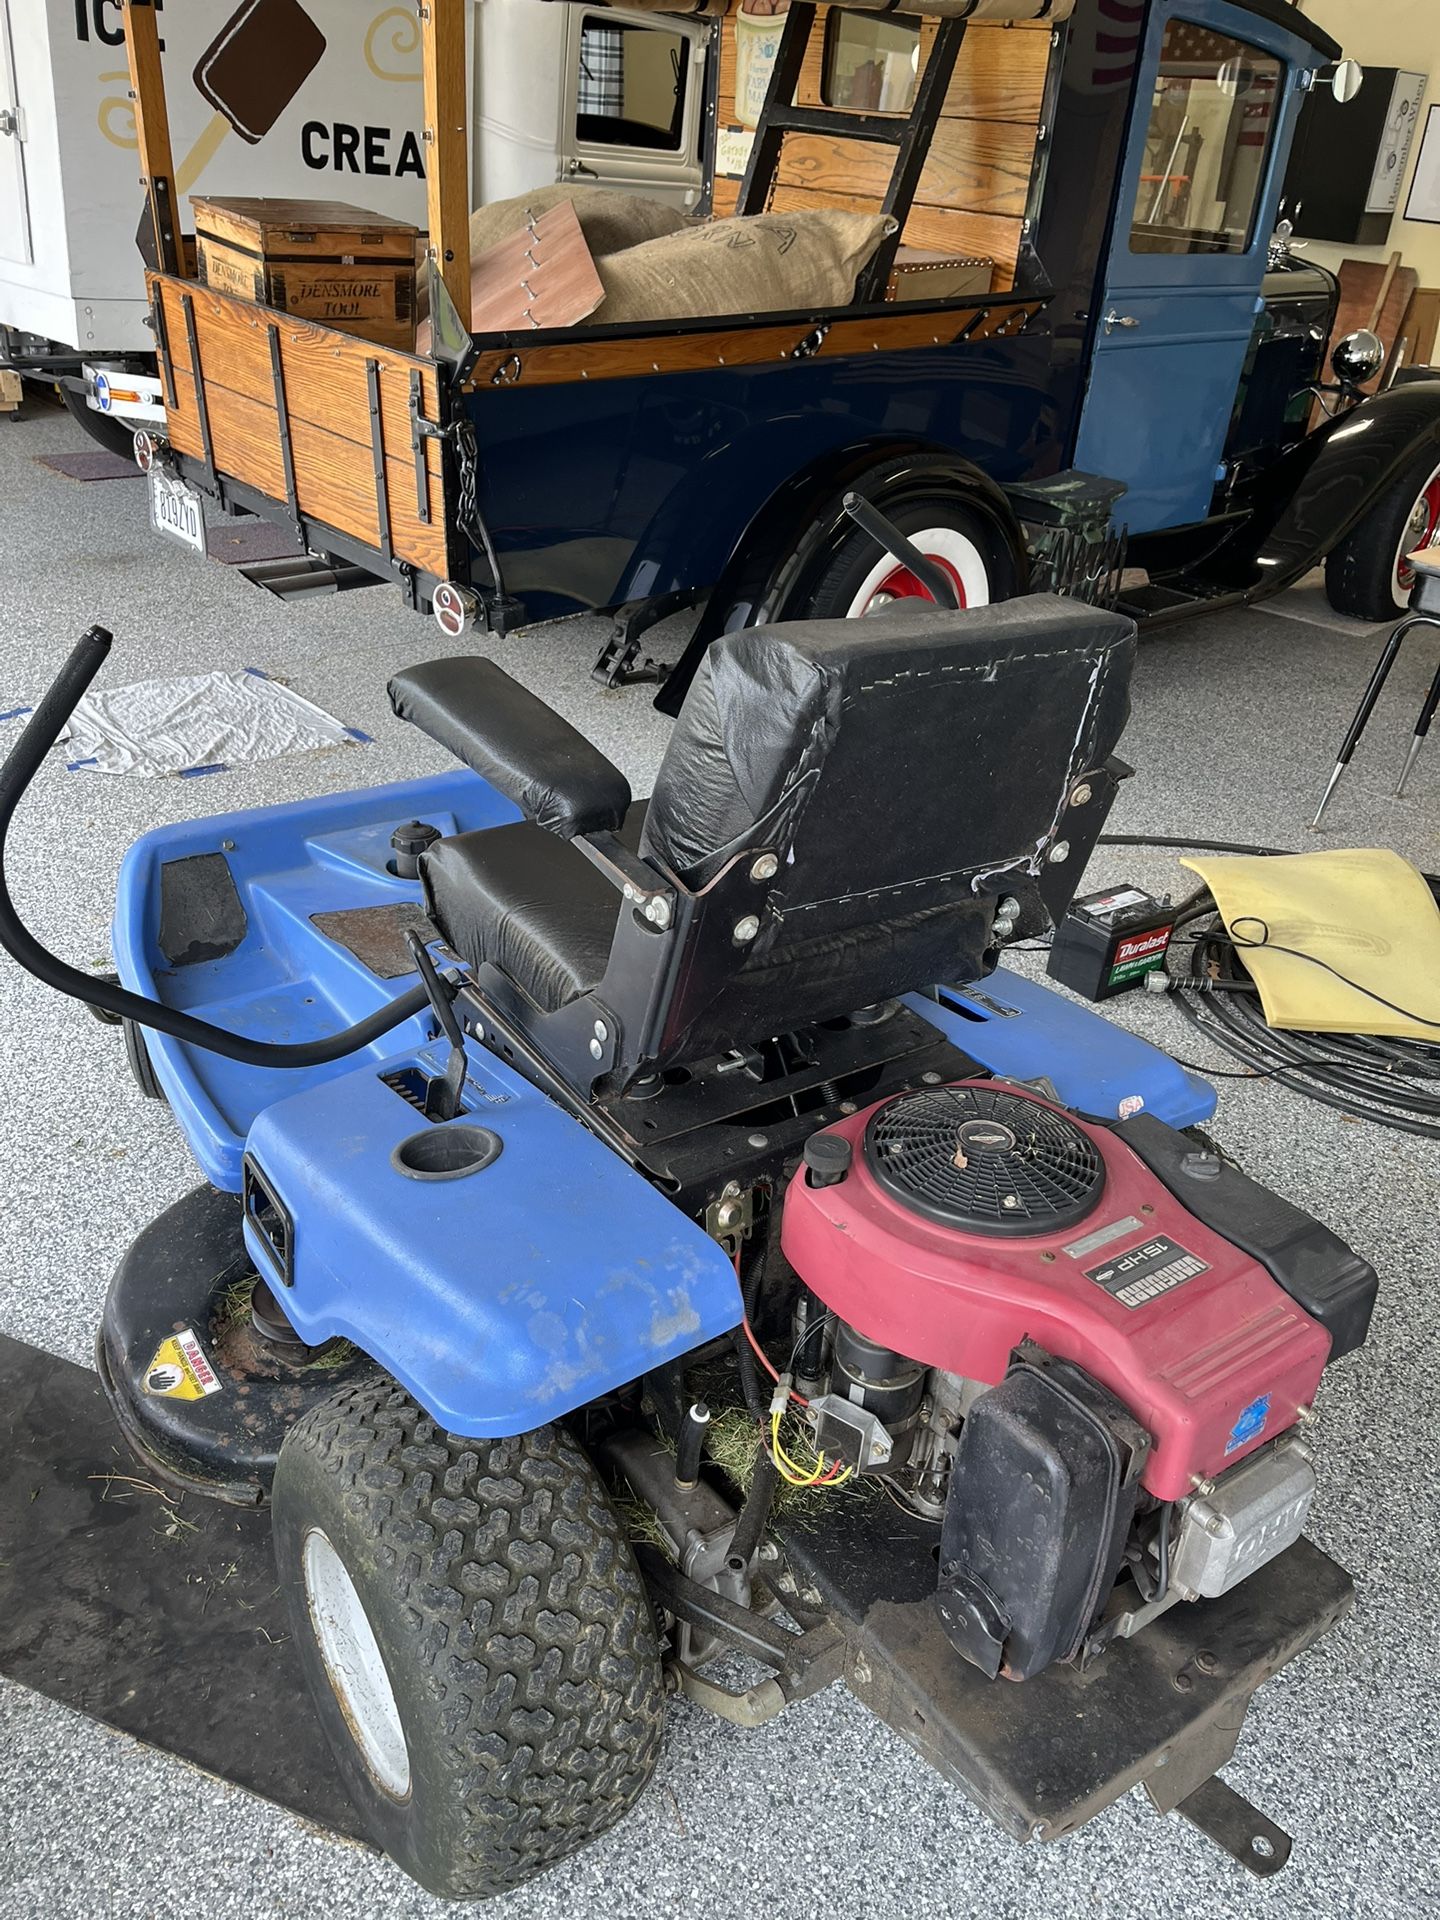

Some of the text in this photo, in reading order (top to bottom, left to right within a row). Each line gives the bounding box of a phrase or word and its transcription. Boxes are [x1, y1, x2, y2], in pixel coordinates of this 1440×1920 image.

[74, 0, 165, 52] IC
[302, 121, 426, 179] CREA
[1388, 78, 1425, 205] Remember When
[300, 283, 381, 299] DENSMORE
[324, 301, 362, 316] TOOL
[1119, 931, 1169, 958] Duralast
[1115, 1254, 1207, 1307] VANGUARD
[183, 1340, 214, 1386] DANGER
